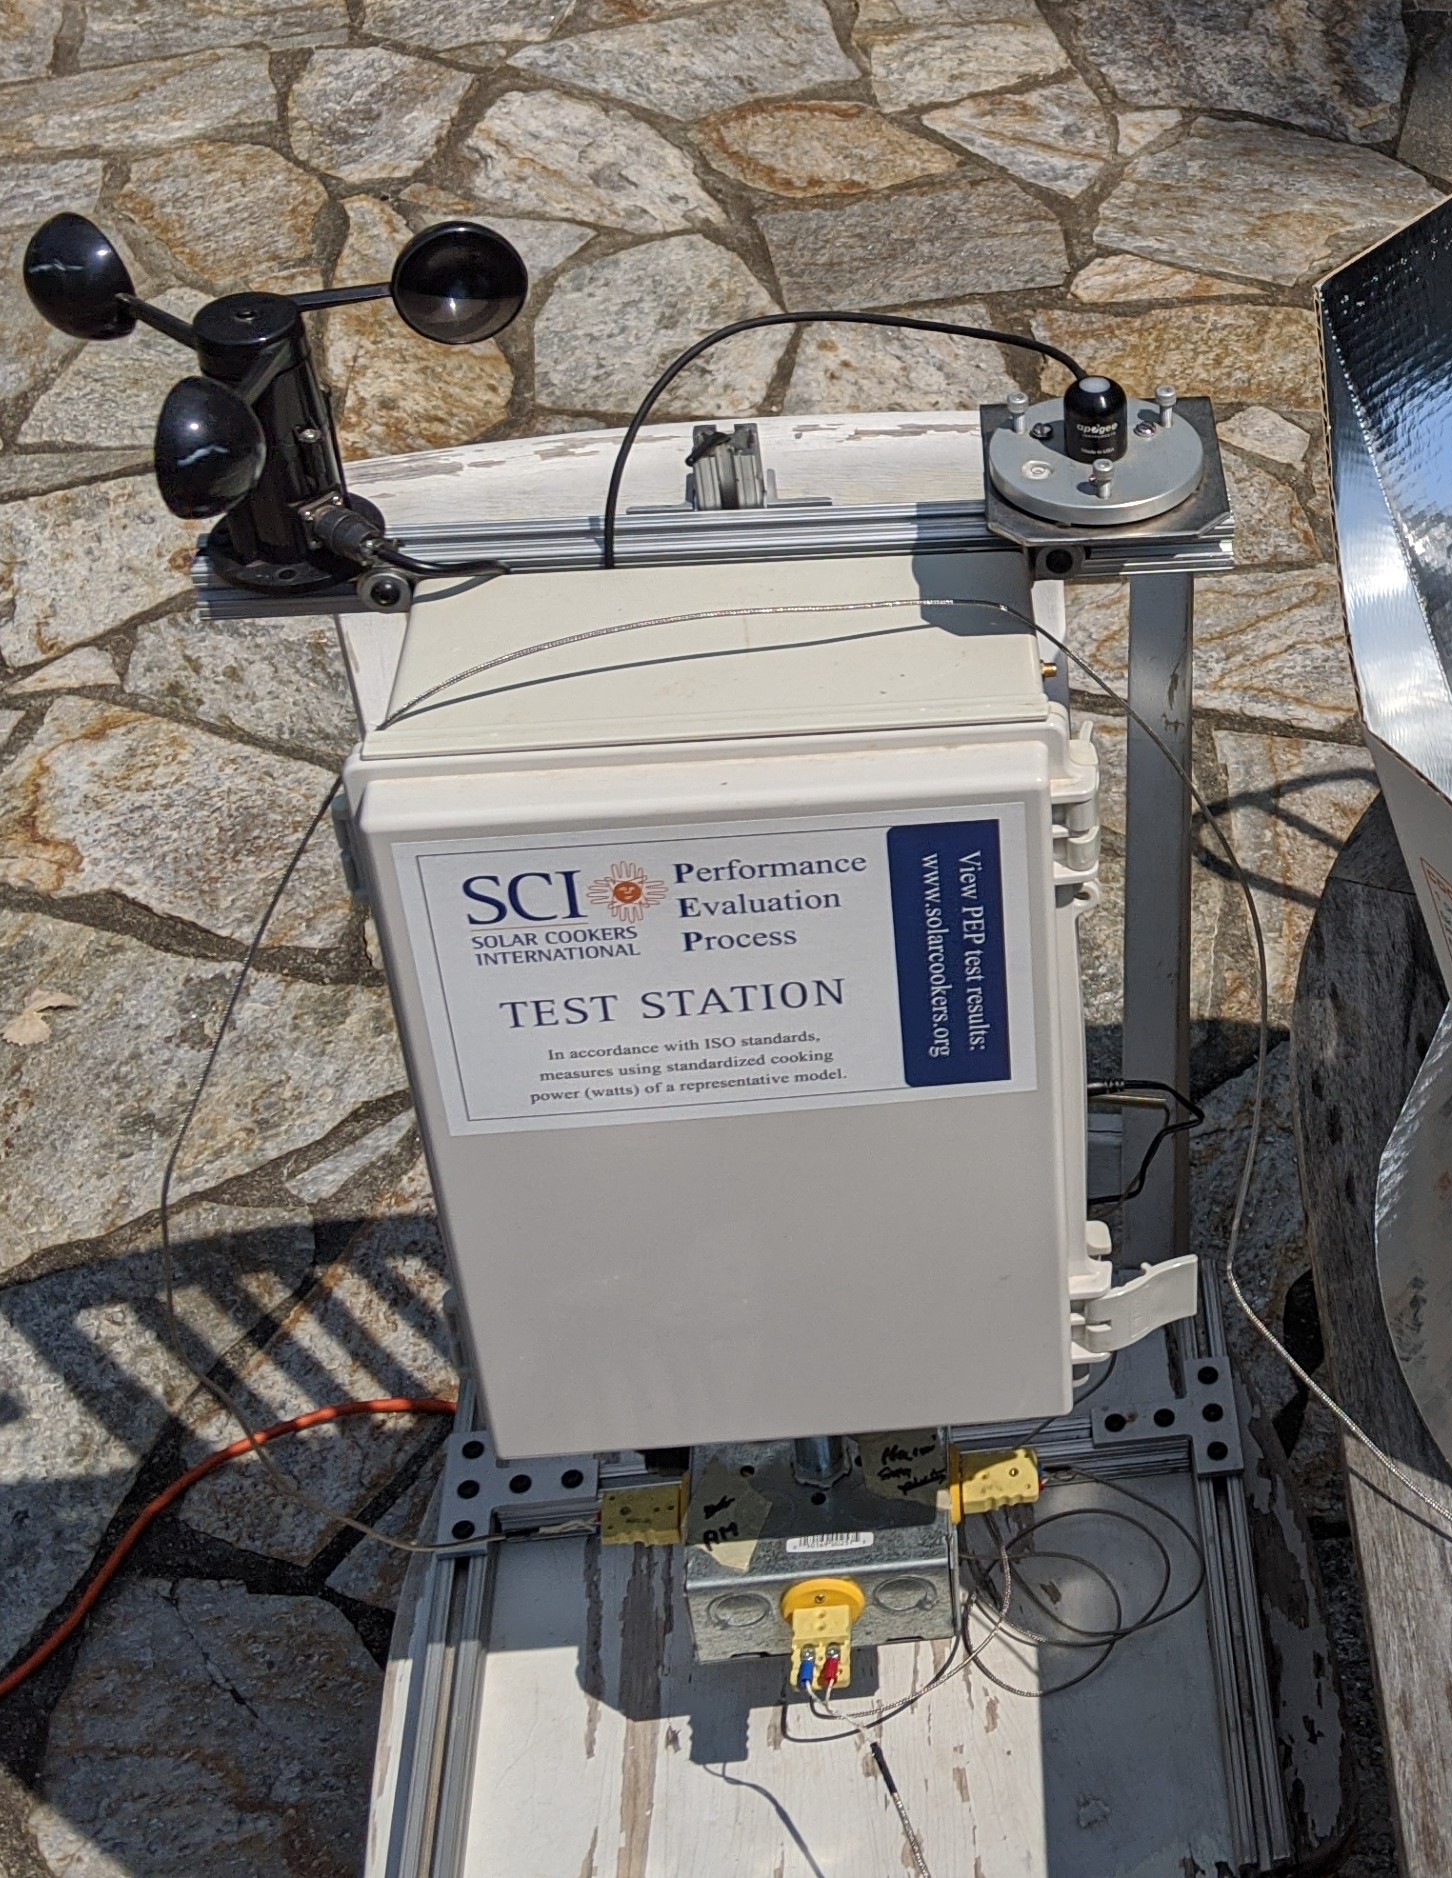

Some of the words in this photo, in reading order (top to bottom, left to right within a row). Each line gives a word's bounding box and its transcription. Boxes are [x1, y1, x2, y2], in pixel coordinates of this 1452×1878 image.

[1076, 422, 1118, 434] apogee
[673, 856, 867, 884] Performance
[958, 850, 981, 900] View
[462, 869, 589, 925] SCI
[677, 889, 842, 918] Evaluation
[471, 932, 538, 949] SOLAR
[545, 926, 638, 945] COOKERS
[681, 929, 797, 952] Process
[961, 905, 986, 945] PEP
[475, 943, 641, 966] INTERNATIONAL
[921, 852, 952, 1058] www.solarcookers.org
[964, 948, 985, 982] test
[499, 994, 618, 1029] TEST
[640, 978, 846, 1019] STATION
[966, 986, 991, 1051] results:
[548, 1049, 565, 1060] In
[570, 1045, 659, 1059] accordance
[664, 1040, 699, 1053] with
[704, 1036, 736, 1049] ISO
[741, 1030, 821, 1047] standards,
[539, 1067, 614, 1081] measures
[618, 1063, 662, 1076] using
[666, 1054, 766, 1073] standardized
[770, 1050, 834, 1063] cooking
[530, 1090, 580, 1105] power
[585, 1084, 640, 1100] (watts)
[644, 1081, 663, 1094] of
[680, 1073, 790, 1093] representative
[794, 1067, 847, 1083] model.
